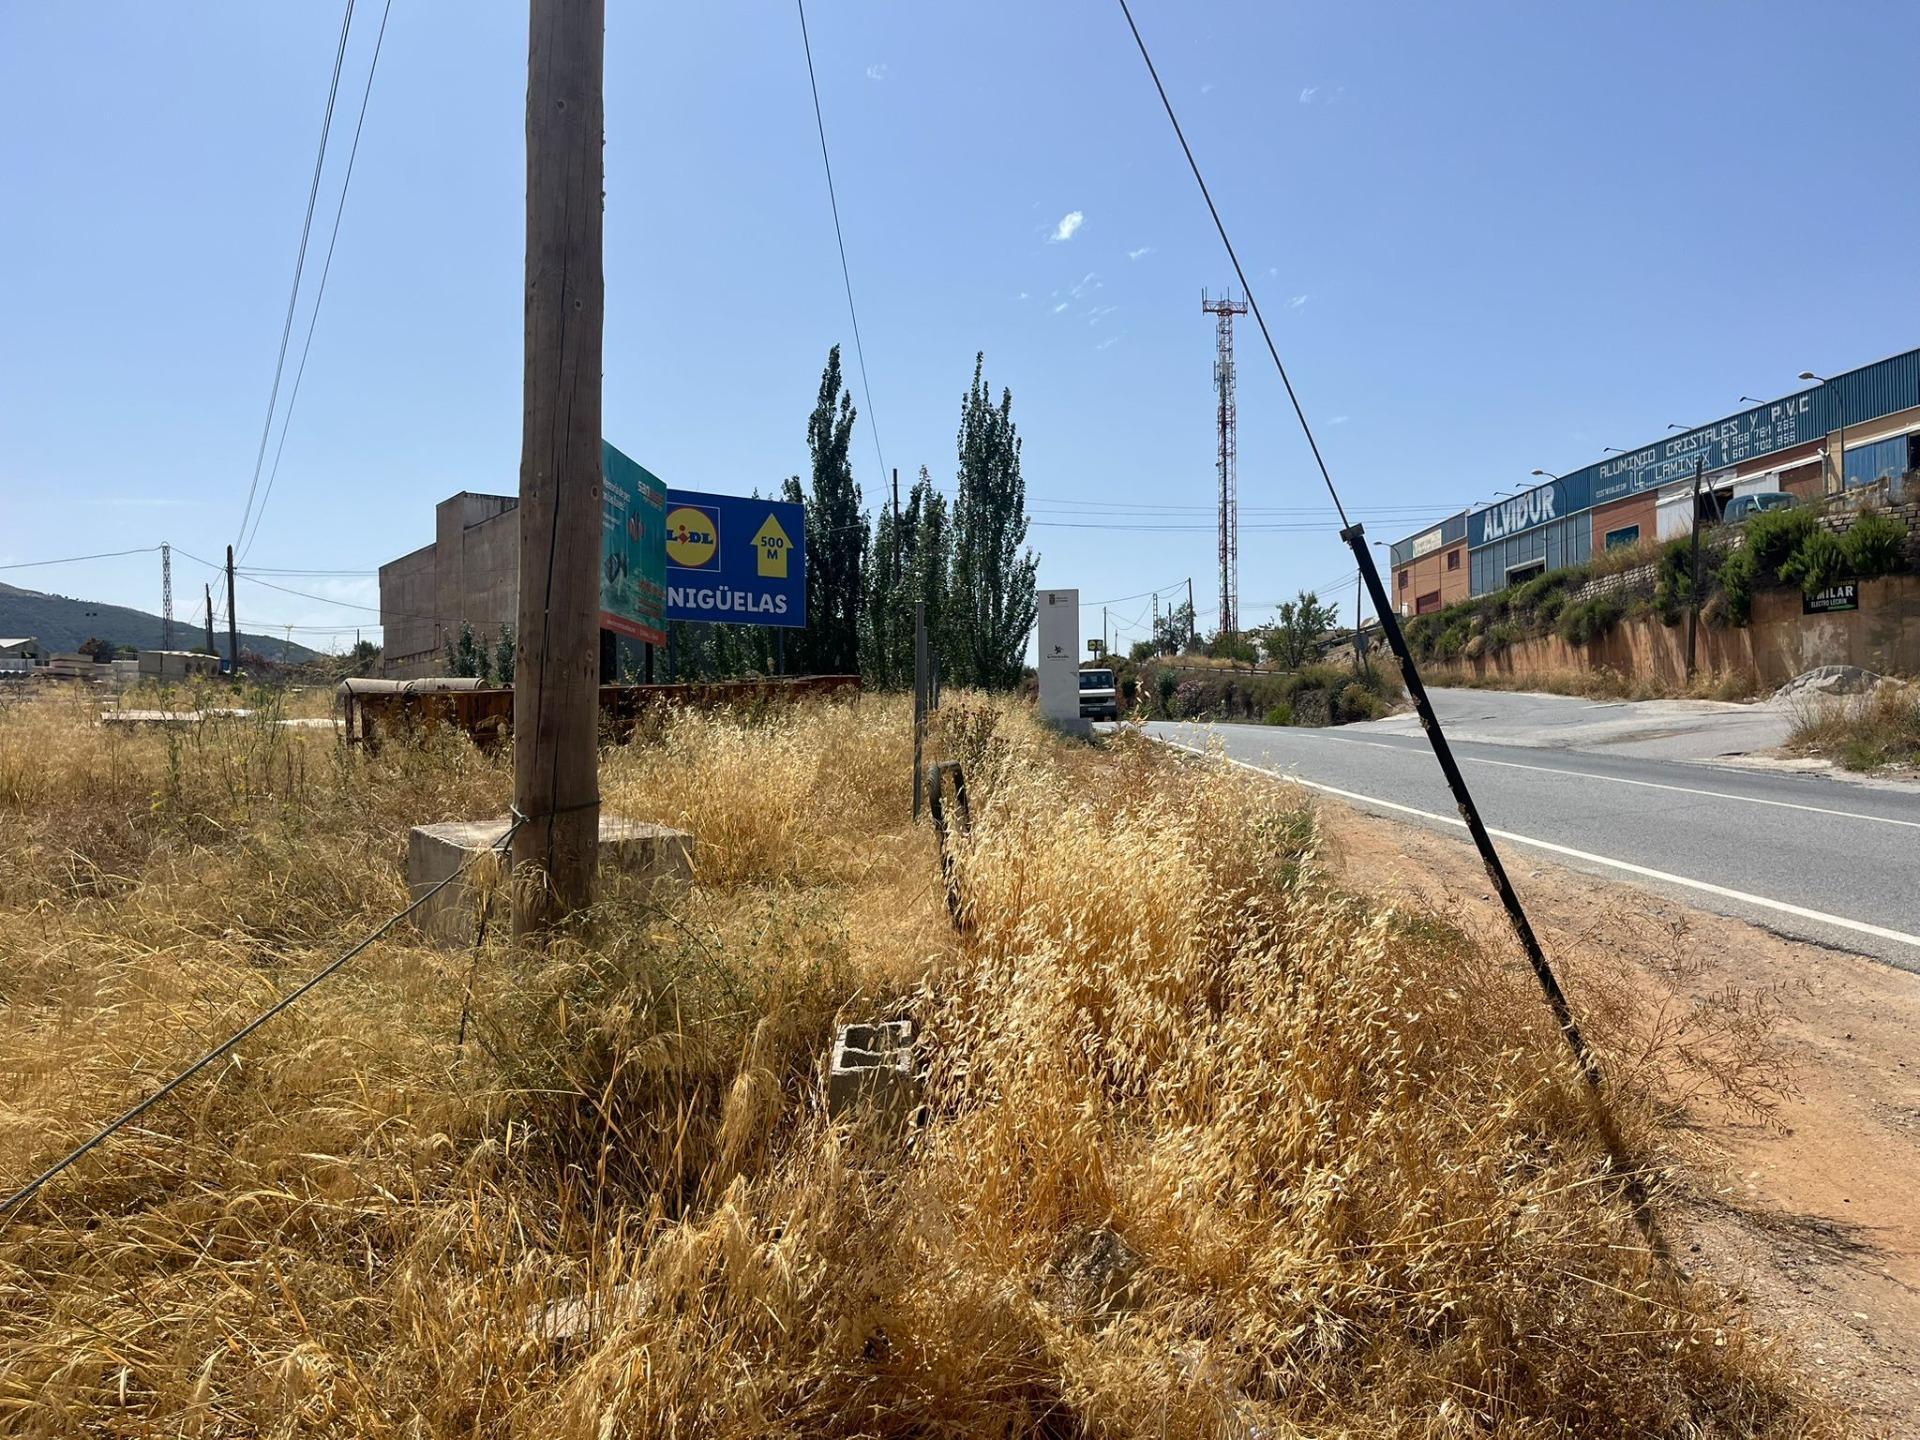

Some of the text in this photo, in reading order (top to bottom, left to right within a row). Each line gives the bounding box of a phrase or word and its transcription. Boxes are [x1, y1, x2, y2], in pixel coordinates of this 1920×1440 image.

[1600, 448, 1656, 479] ALUMINIO
[1665, 420, 1739, 457] CRISTALES
[1749, 412, 1758, 432] Y
[1732, 432, 1750, 446] 958
[1732, 446, 1750, 459] 607
[1483, 485, 1556, 542] ALVIDUR
[760, 536, 784, 549] 500
[767, 549, 778, 560] M
[667, 586, 788, 614] NIGÜELAS
